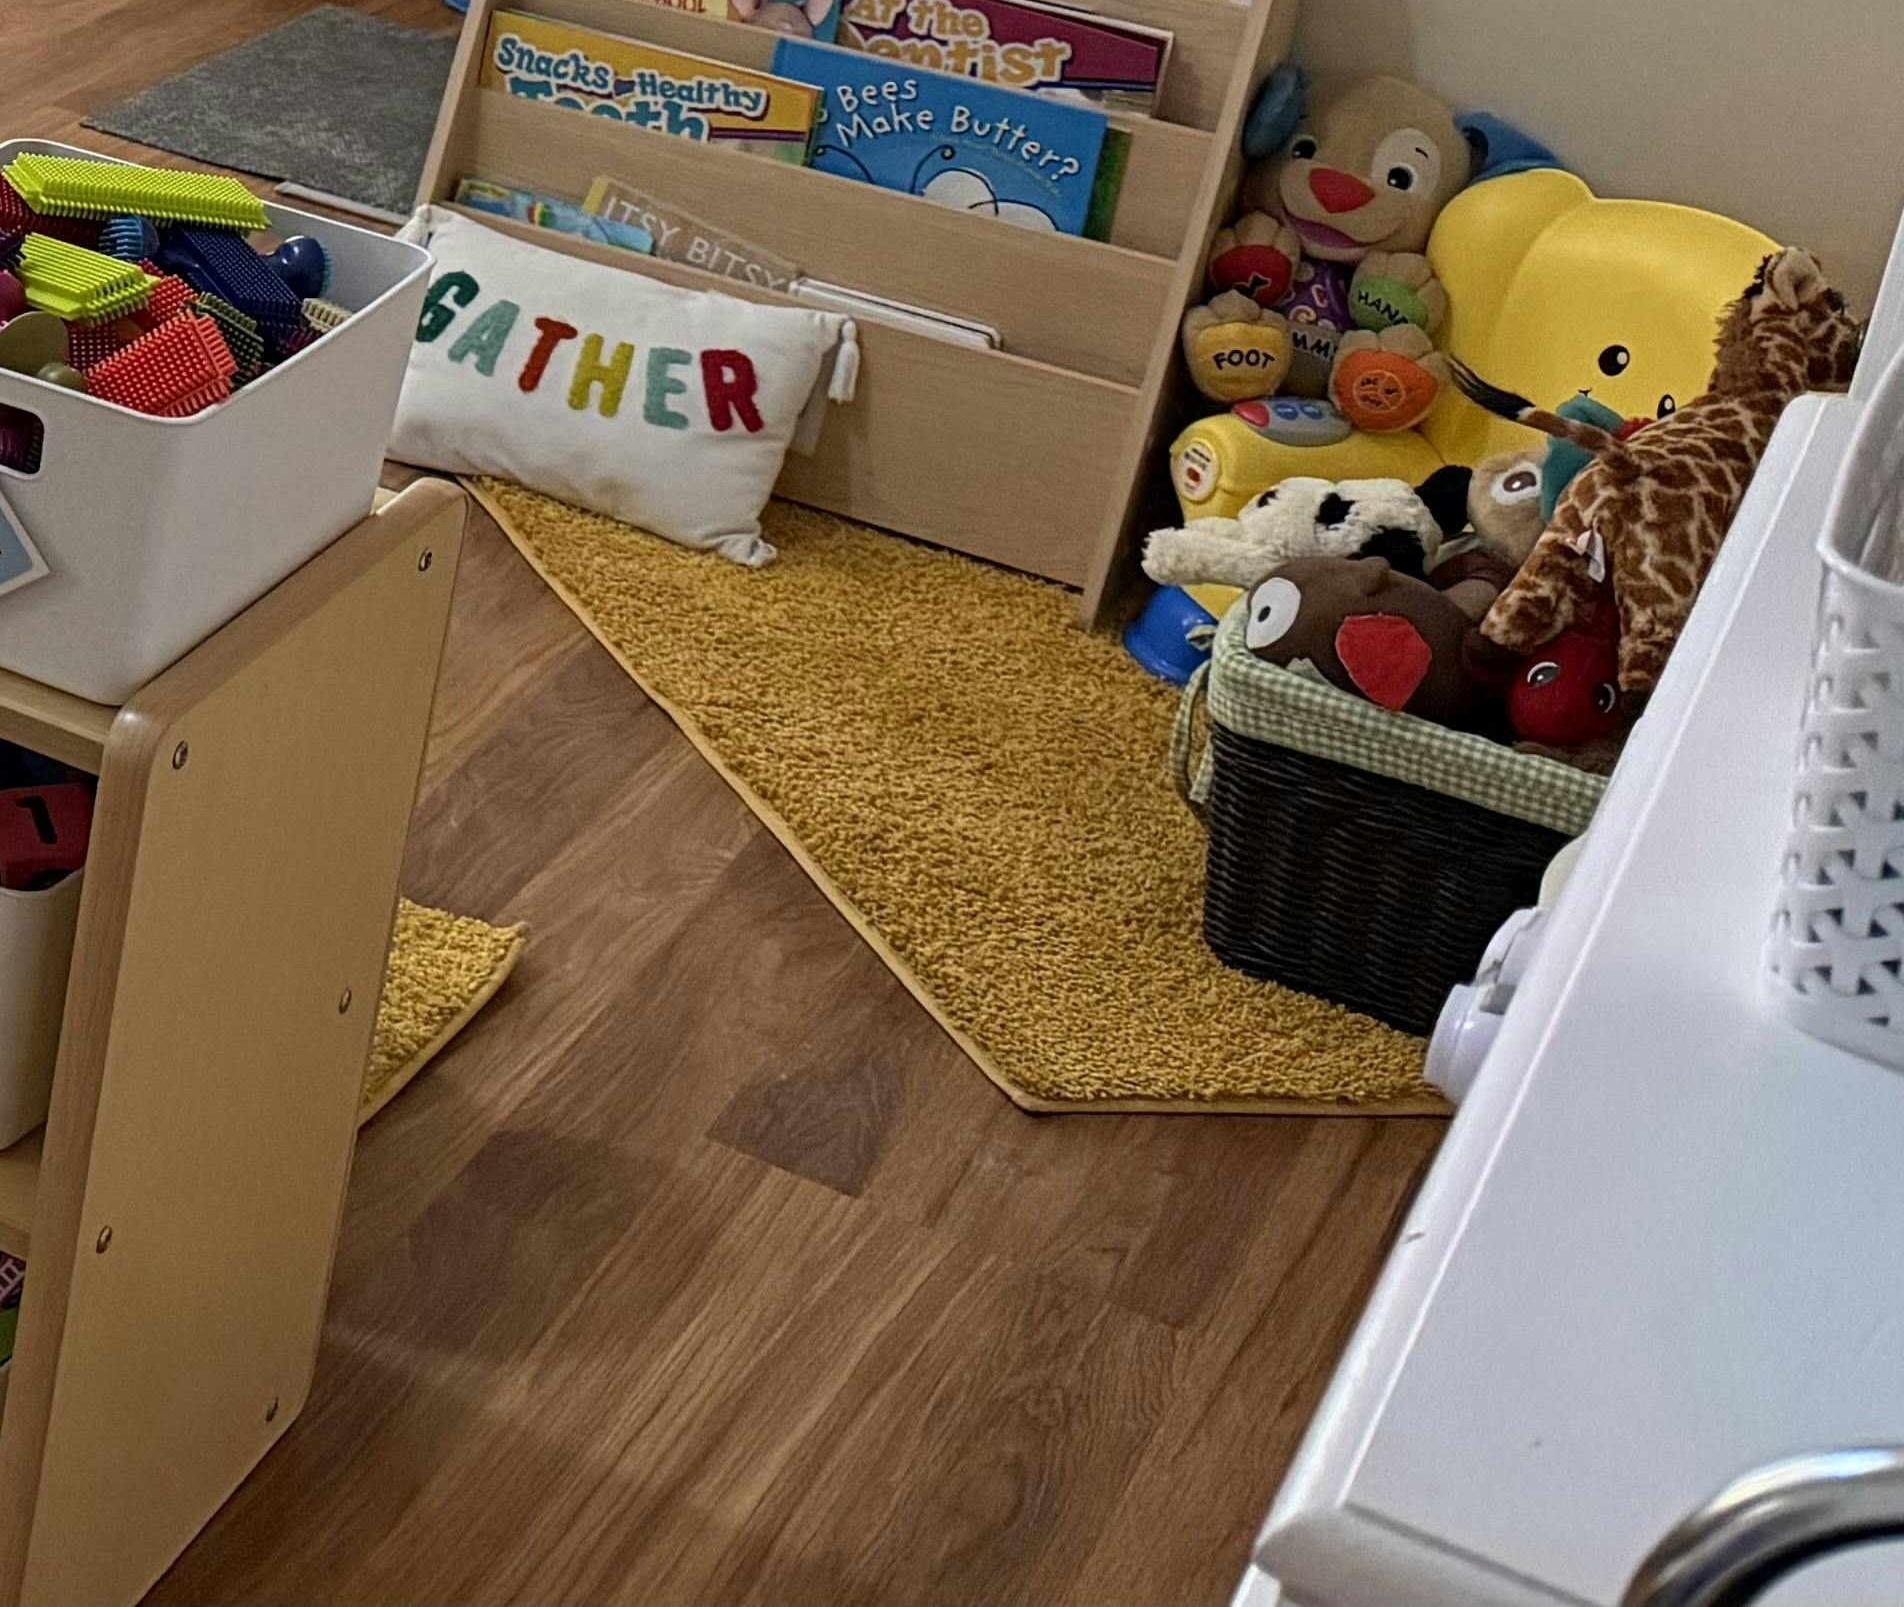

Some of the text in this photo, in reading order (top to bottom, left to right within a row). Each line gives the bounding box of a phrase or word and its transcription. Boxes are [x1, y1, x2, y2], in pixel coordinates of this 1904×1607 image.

[494, 33, 770, 121] Snacks Healthy
[836, 78, 918, 113] Bees
[836, 103, 1080, 181] Make Butter?
[603, 196, 789, 293] ITSY BITSY
[414, 270, 764, 433] GATHER
[1212, 349, 1276, 371] FOOT
